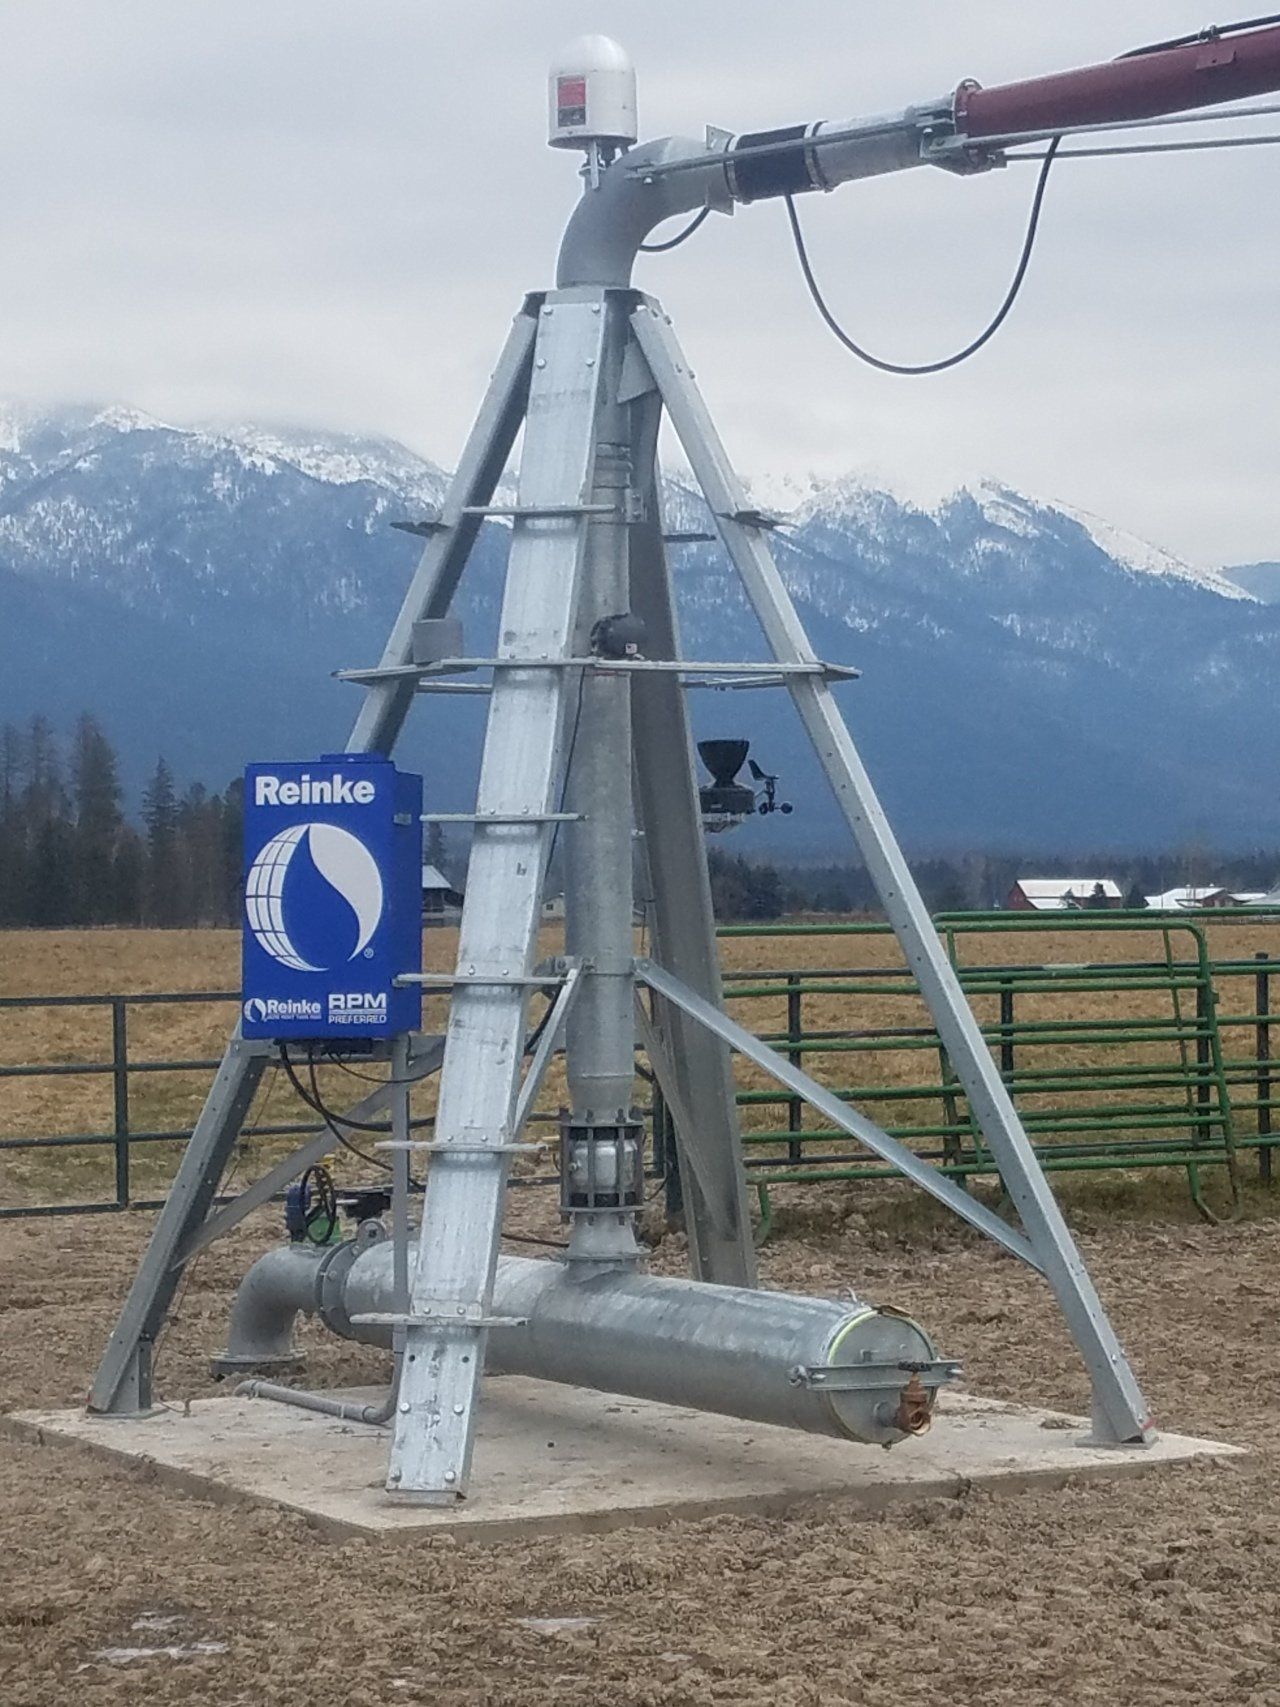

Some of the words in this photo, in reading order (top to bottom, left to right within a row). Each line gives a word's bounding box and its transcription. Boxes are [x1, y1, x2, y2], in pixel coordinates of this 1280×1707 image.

[255, 774, 376, 805] Reinke
[266, 999, 322, 1014] Reinke
[328, 993, 387, 1009] RPM
